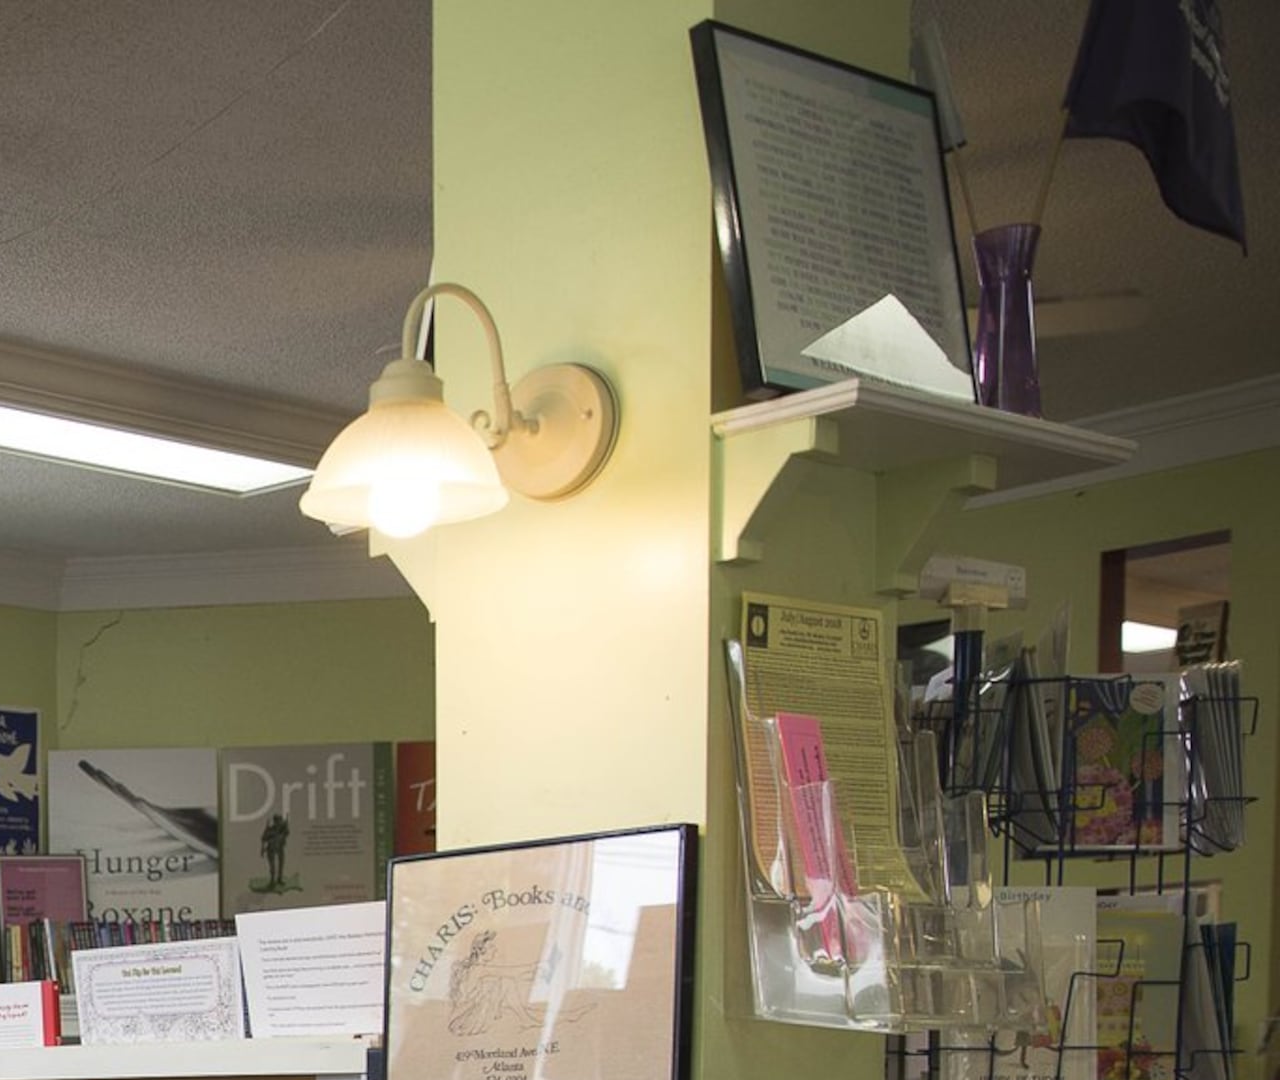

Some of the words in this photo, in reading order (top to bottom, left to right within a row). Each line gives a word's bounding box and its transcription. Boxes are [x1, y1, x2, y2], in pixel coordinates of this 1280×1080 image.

[228, 753, 367, 823] Drift
[481, 885, 555, 912] Books
[482, 1061, 524, 1074] Atlanta
